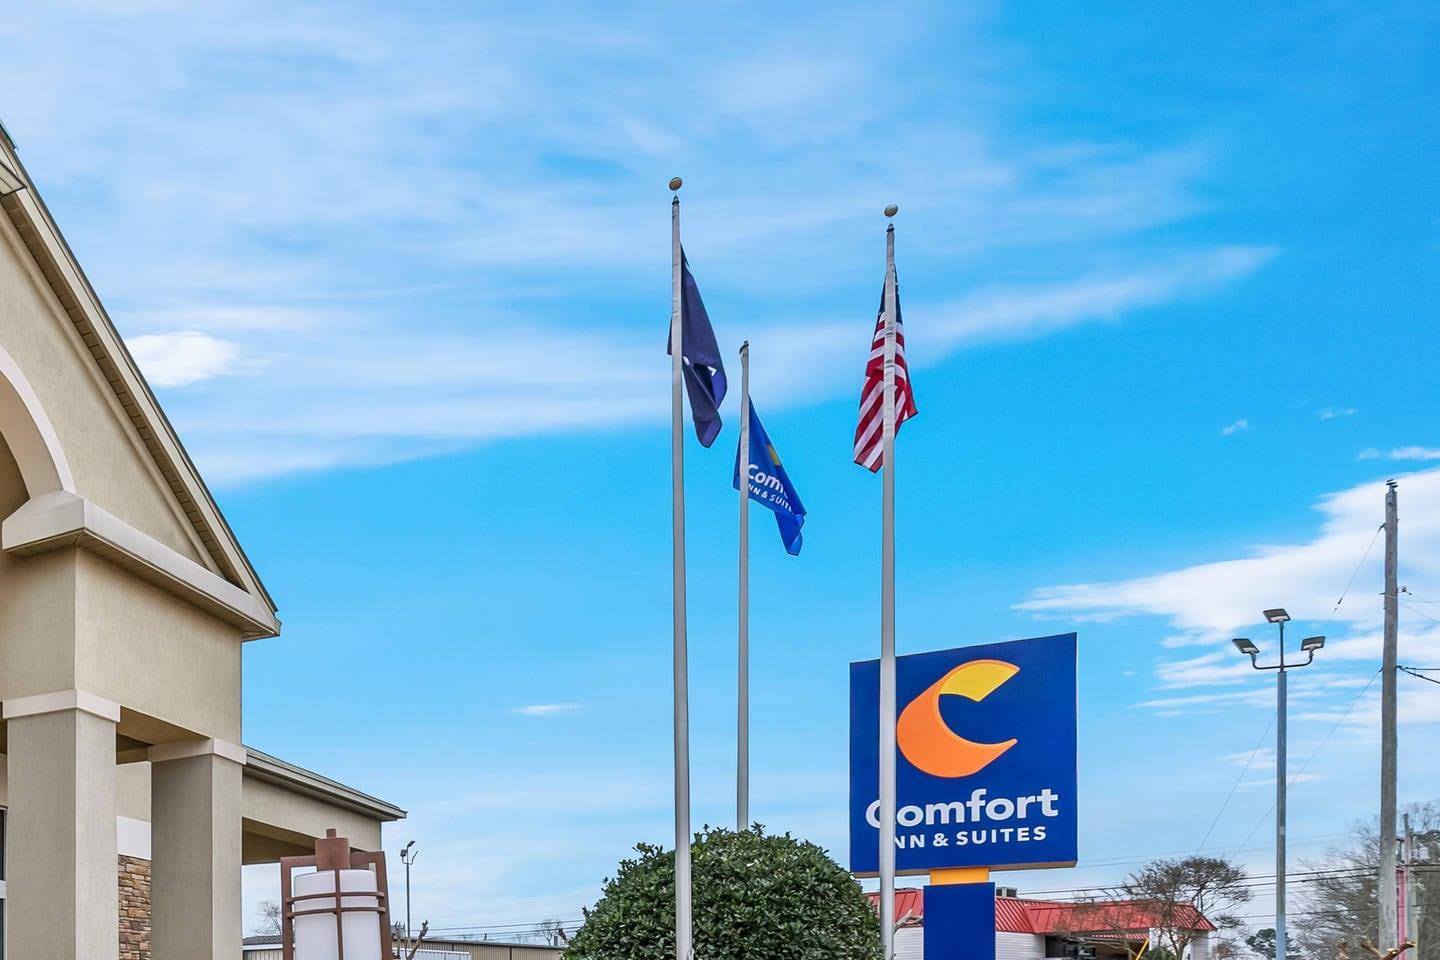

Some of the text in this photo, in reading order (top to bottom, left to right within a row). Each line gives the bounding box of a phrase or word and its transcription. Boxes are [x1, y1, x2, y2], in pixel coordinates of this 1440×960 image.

[748, 464, 789, 499] Com
[748, 483, 793, 513] NN & SUIT
[865, 788, 1059, 829] Comfort
[894, 826, 1047, 849] NN & SUITES
